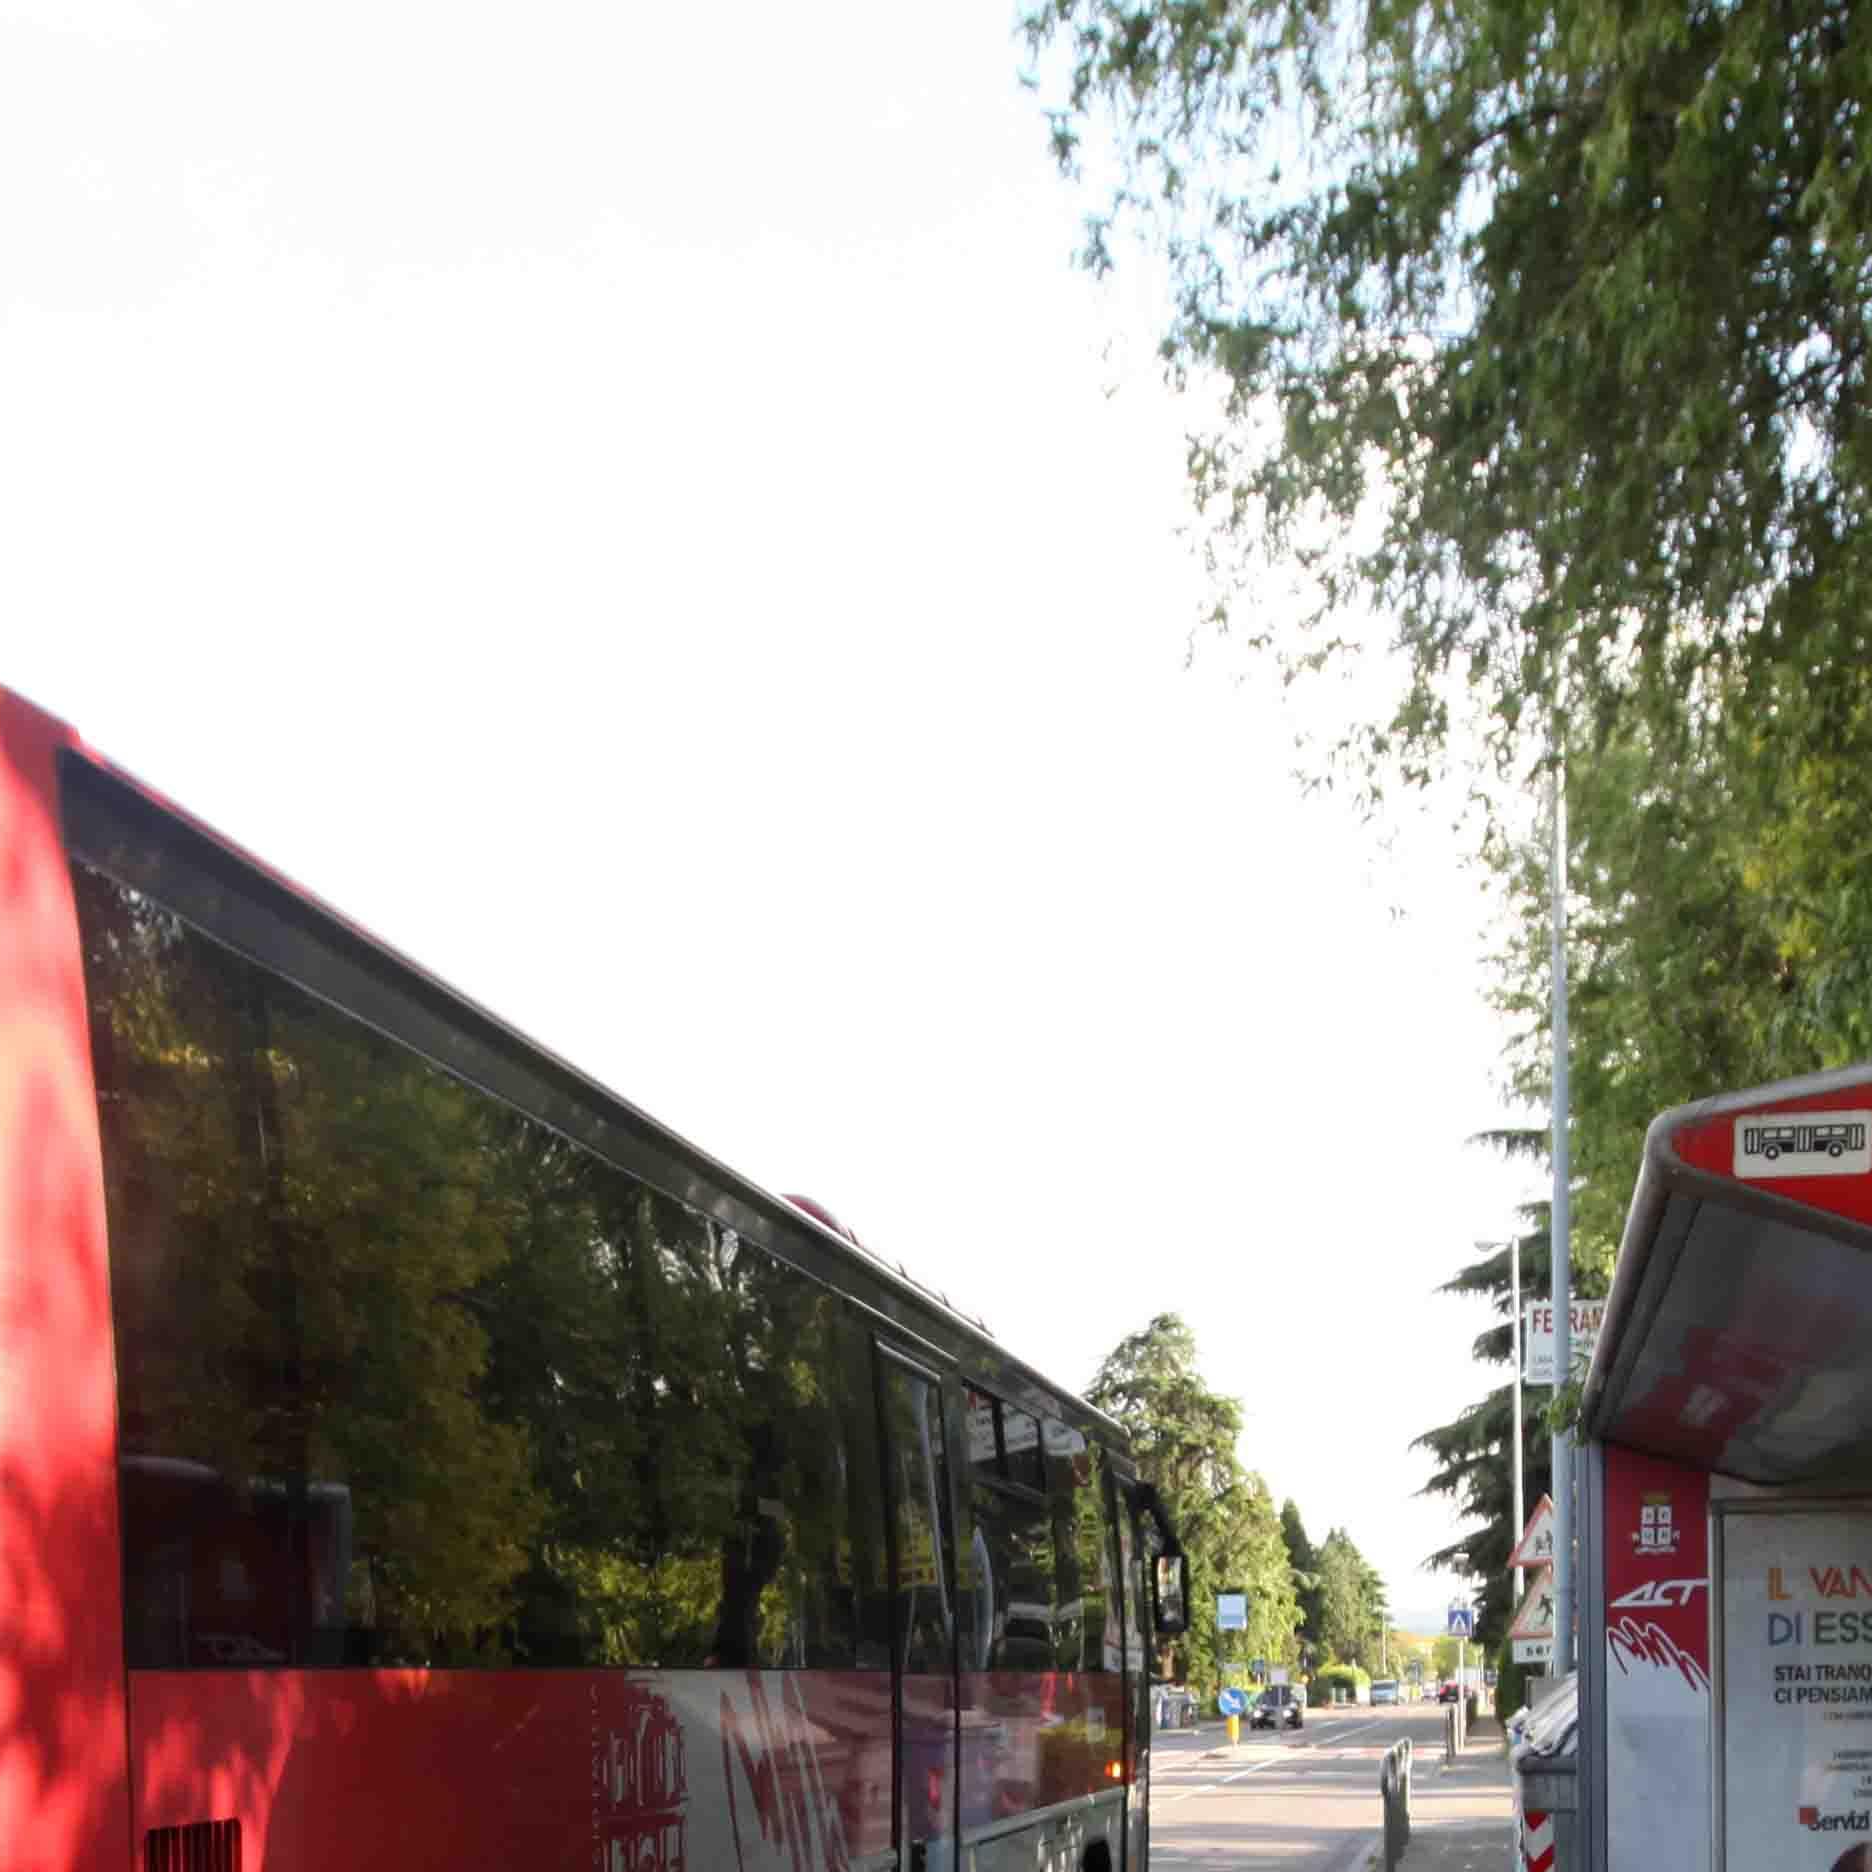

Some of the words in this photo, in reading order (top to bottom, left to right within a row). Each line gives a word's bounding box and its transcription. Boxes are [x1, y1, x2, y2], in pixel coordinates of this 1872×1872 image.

[1609, 1579, 1711, 1607] ACT
[1768, 1567, 1792, 1601] IL
[1768, 1612, 1801, 1646] DI
[1774, 1664, 1813, 1683] STAI
[1774, 1687, 1793, 1704] CI
